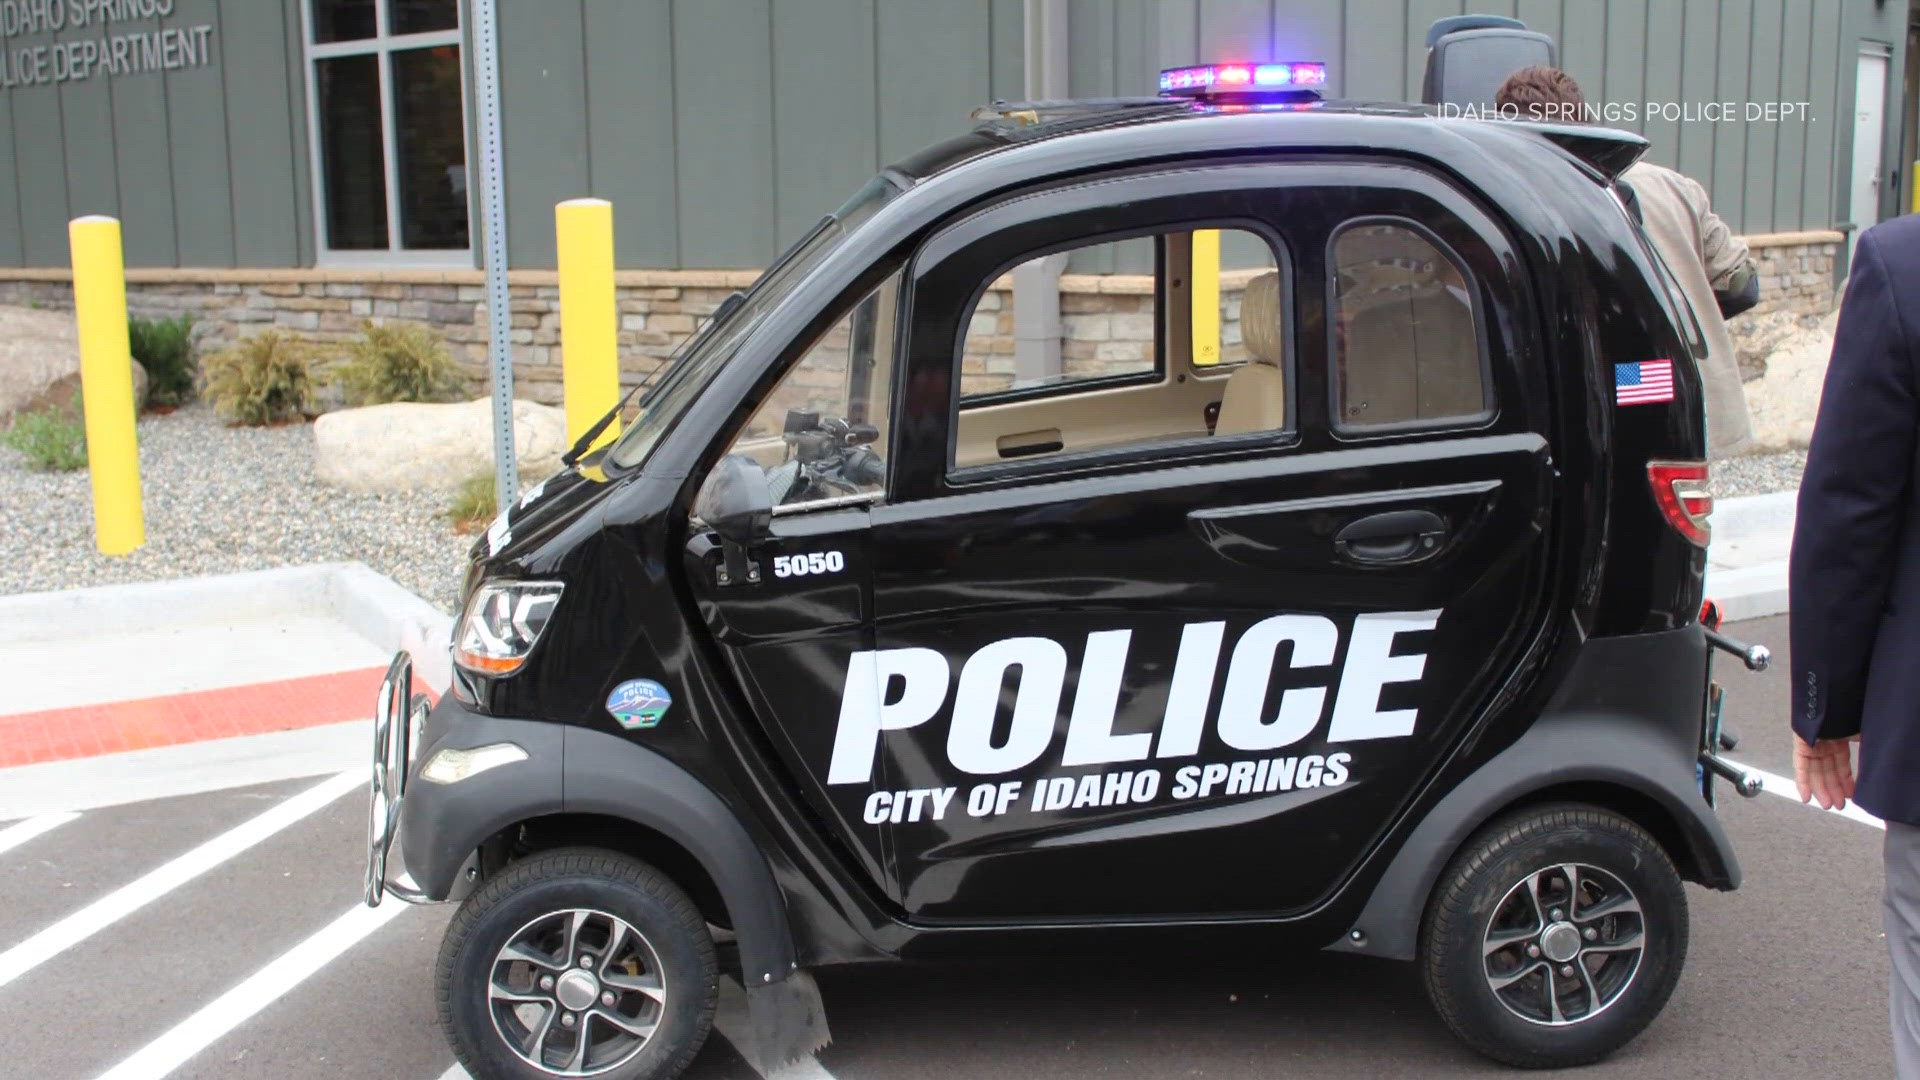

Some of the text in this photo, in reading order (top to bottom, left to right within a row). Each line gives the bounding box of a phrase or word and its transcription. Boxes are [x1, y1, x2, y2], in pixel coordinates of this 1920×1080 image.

[0, 24, 213, 87] LICE DEPARTMENT
[773, 550, 844, 578] 5050
[827, 608, 1443, 785] POLICE
[863, 752, 1352, 825] CITY OF IDAHO SPRINGS
